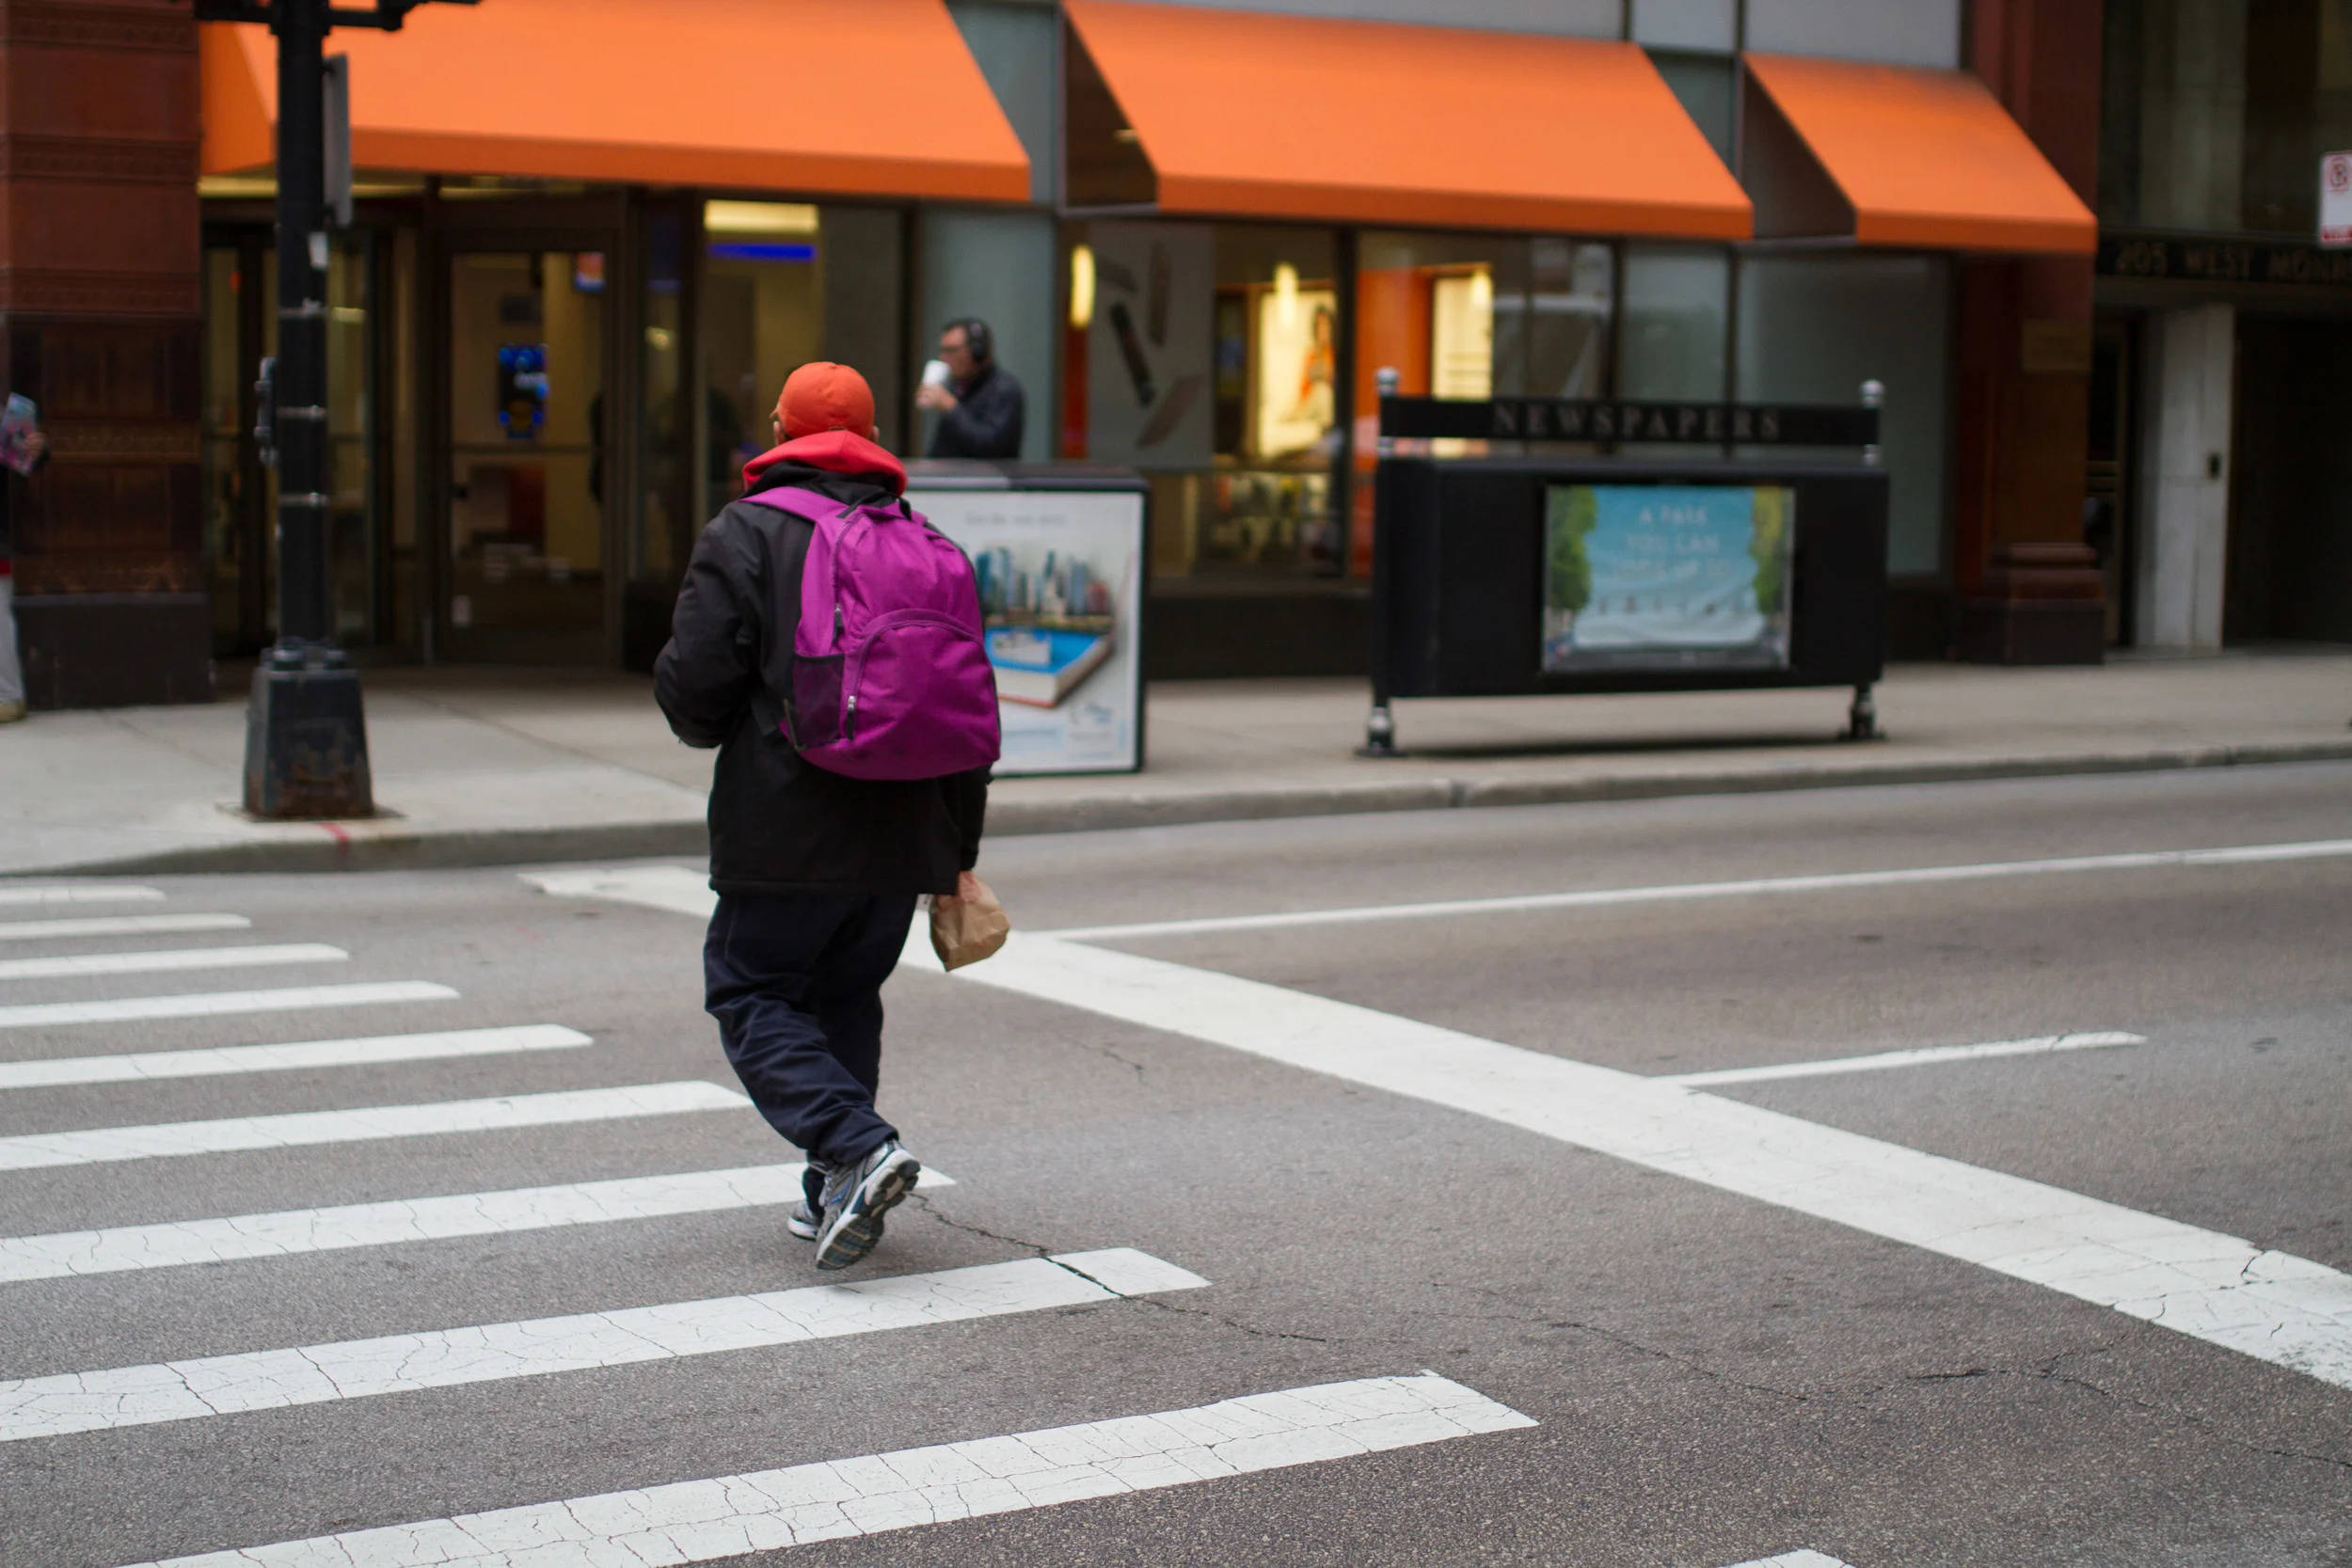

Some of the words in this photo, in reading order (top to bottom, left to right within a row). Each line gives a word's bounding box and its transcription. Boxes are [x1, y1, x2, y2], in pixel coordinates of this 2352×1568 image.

[2116, 241, 2168, 276] 205
[2183, 245, 2250, 281] WEST
[1492, 404, 1781, 439] NEWSPAPERS
